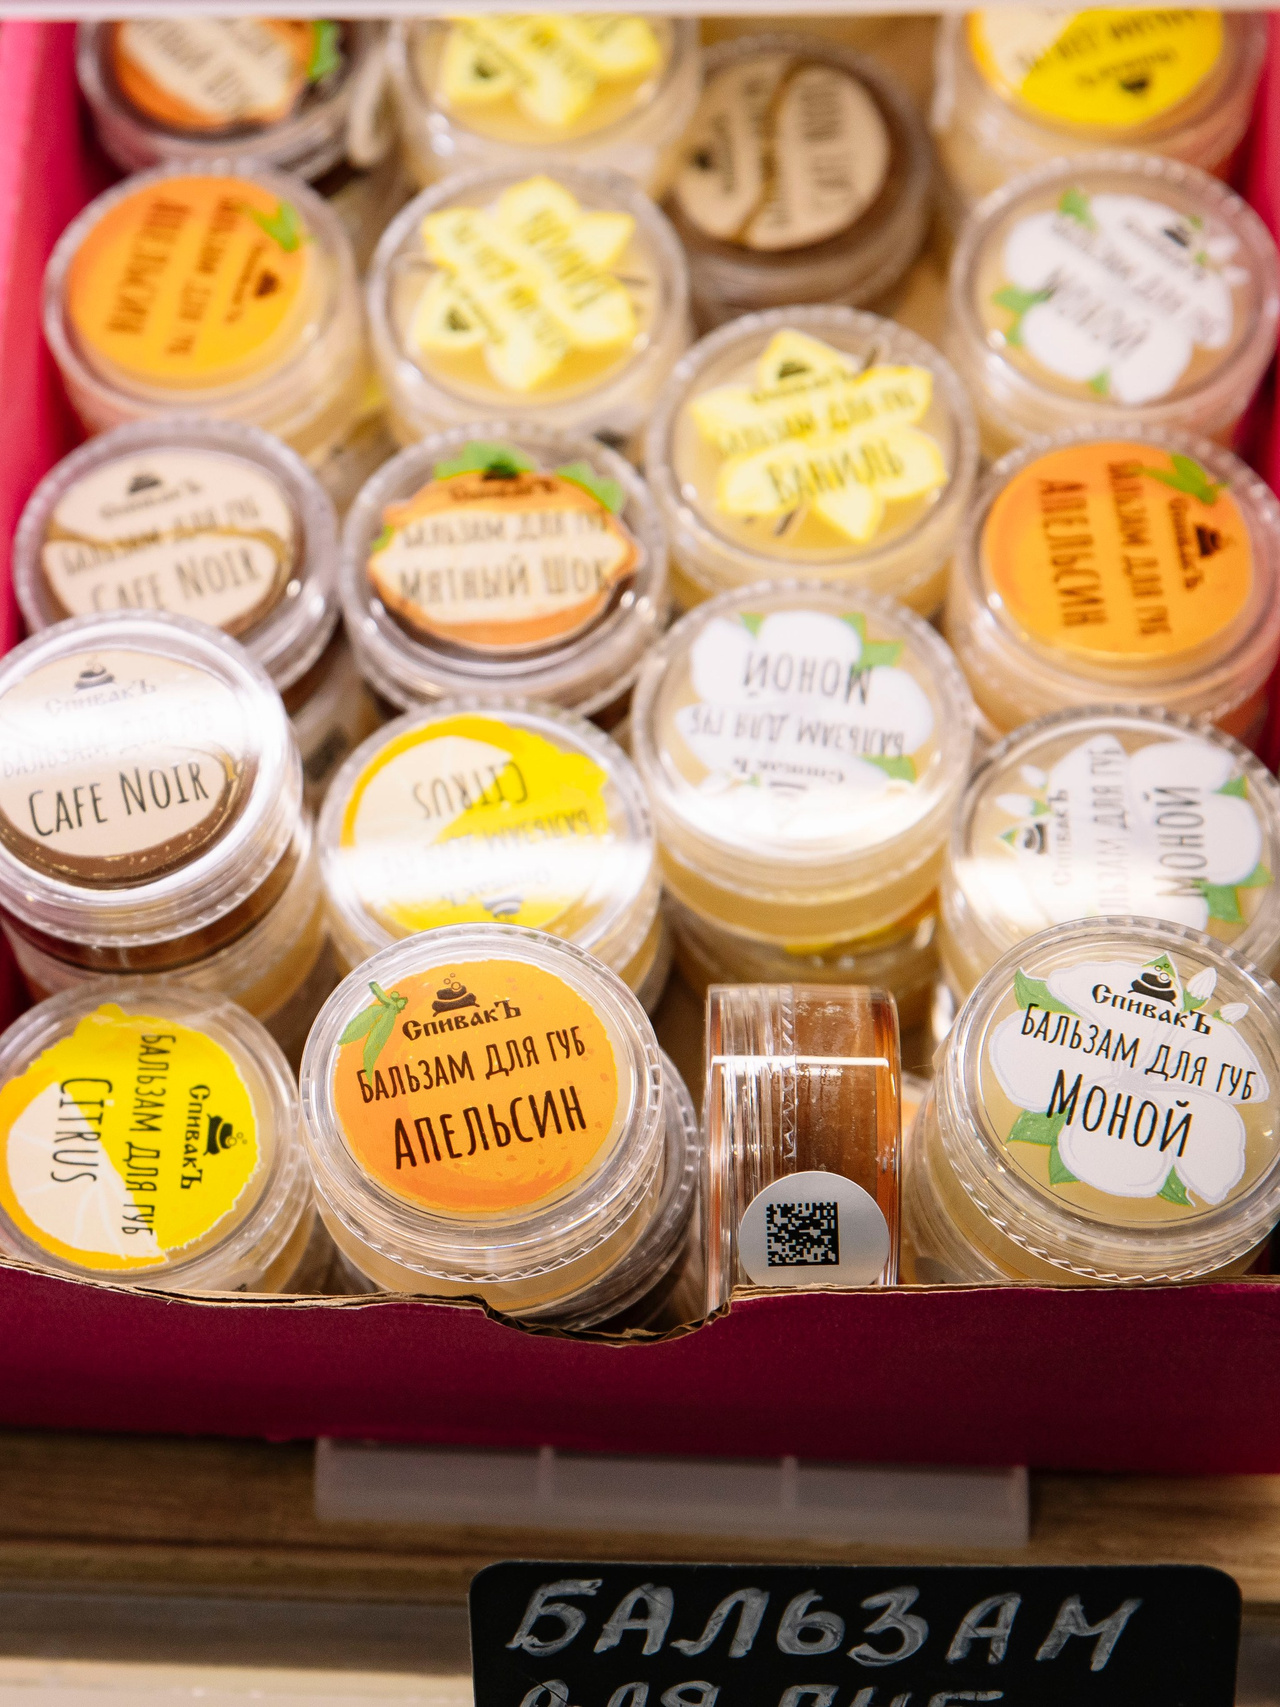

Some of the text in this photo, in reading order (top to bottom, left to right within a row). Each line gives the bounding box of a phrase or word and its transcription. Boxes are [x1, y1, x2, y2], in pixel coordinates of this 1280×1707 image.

[175, 546, 262, 601] NOIR
[1038, 479, 1109, 628] АПЕЛЬСИН
[743, 650, 874, 706] МОНОЙ
[734, 712, 789, 743] ДЛЯ
[796, 715, 905, 760] БАЛЬЗАМ
[28, 762, 209, 836] CAFE NOIR
[413, 761, 530, 820] CITRUS
[1091, 782, 1130, 831] ДЛЯ
[1143, 785, 1208, 898] МОНОЙ
[402, 998, 522, 1041] СпивакЪ
[1092, 983, 1212, 1035] СпивакЪ
[356, 1025, 586, 1103] БАЛЬЗАМ ДЛЯ ГУБ
[1021, 1003, 1257, 1101] БАЛЬЗАМ ДЛЯ ГУБ
[50, 1077, 114, 1184] CITRUS
[121, 1034, 177, 1236] БАЛЬЗАМ ДЛЯ ГУБ
[180, 1083, 211, 1190] СпивакЪ
[394, 1085, 587, 1170] АПЕЛЬСИН
[1047, 1068, 1193, 1158] МОНОЙ
[506, 1578, 1143, 1675] БАЛЬЗАМ
